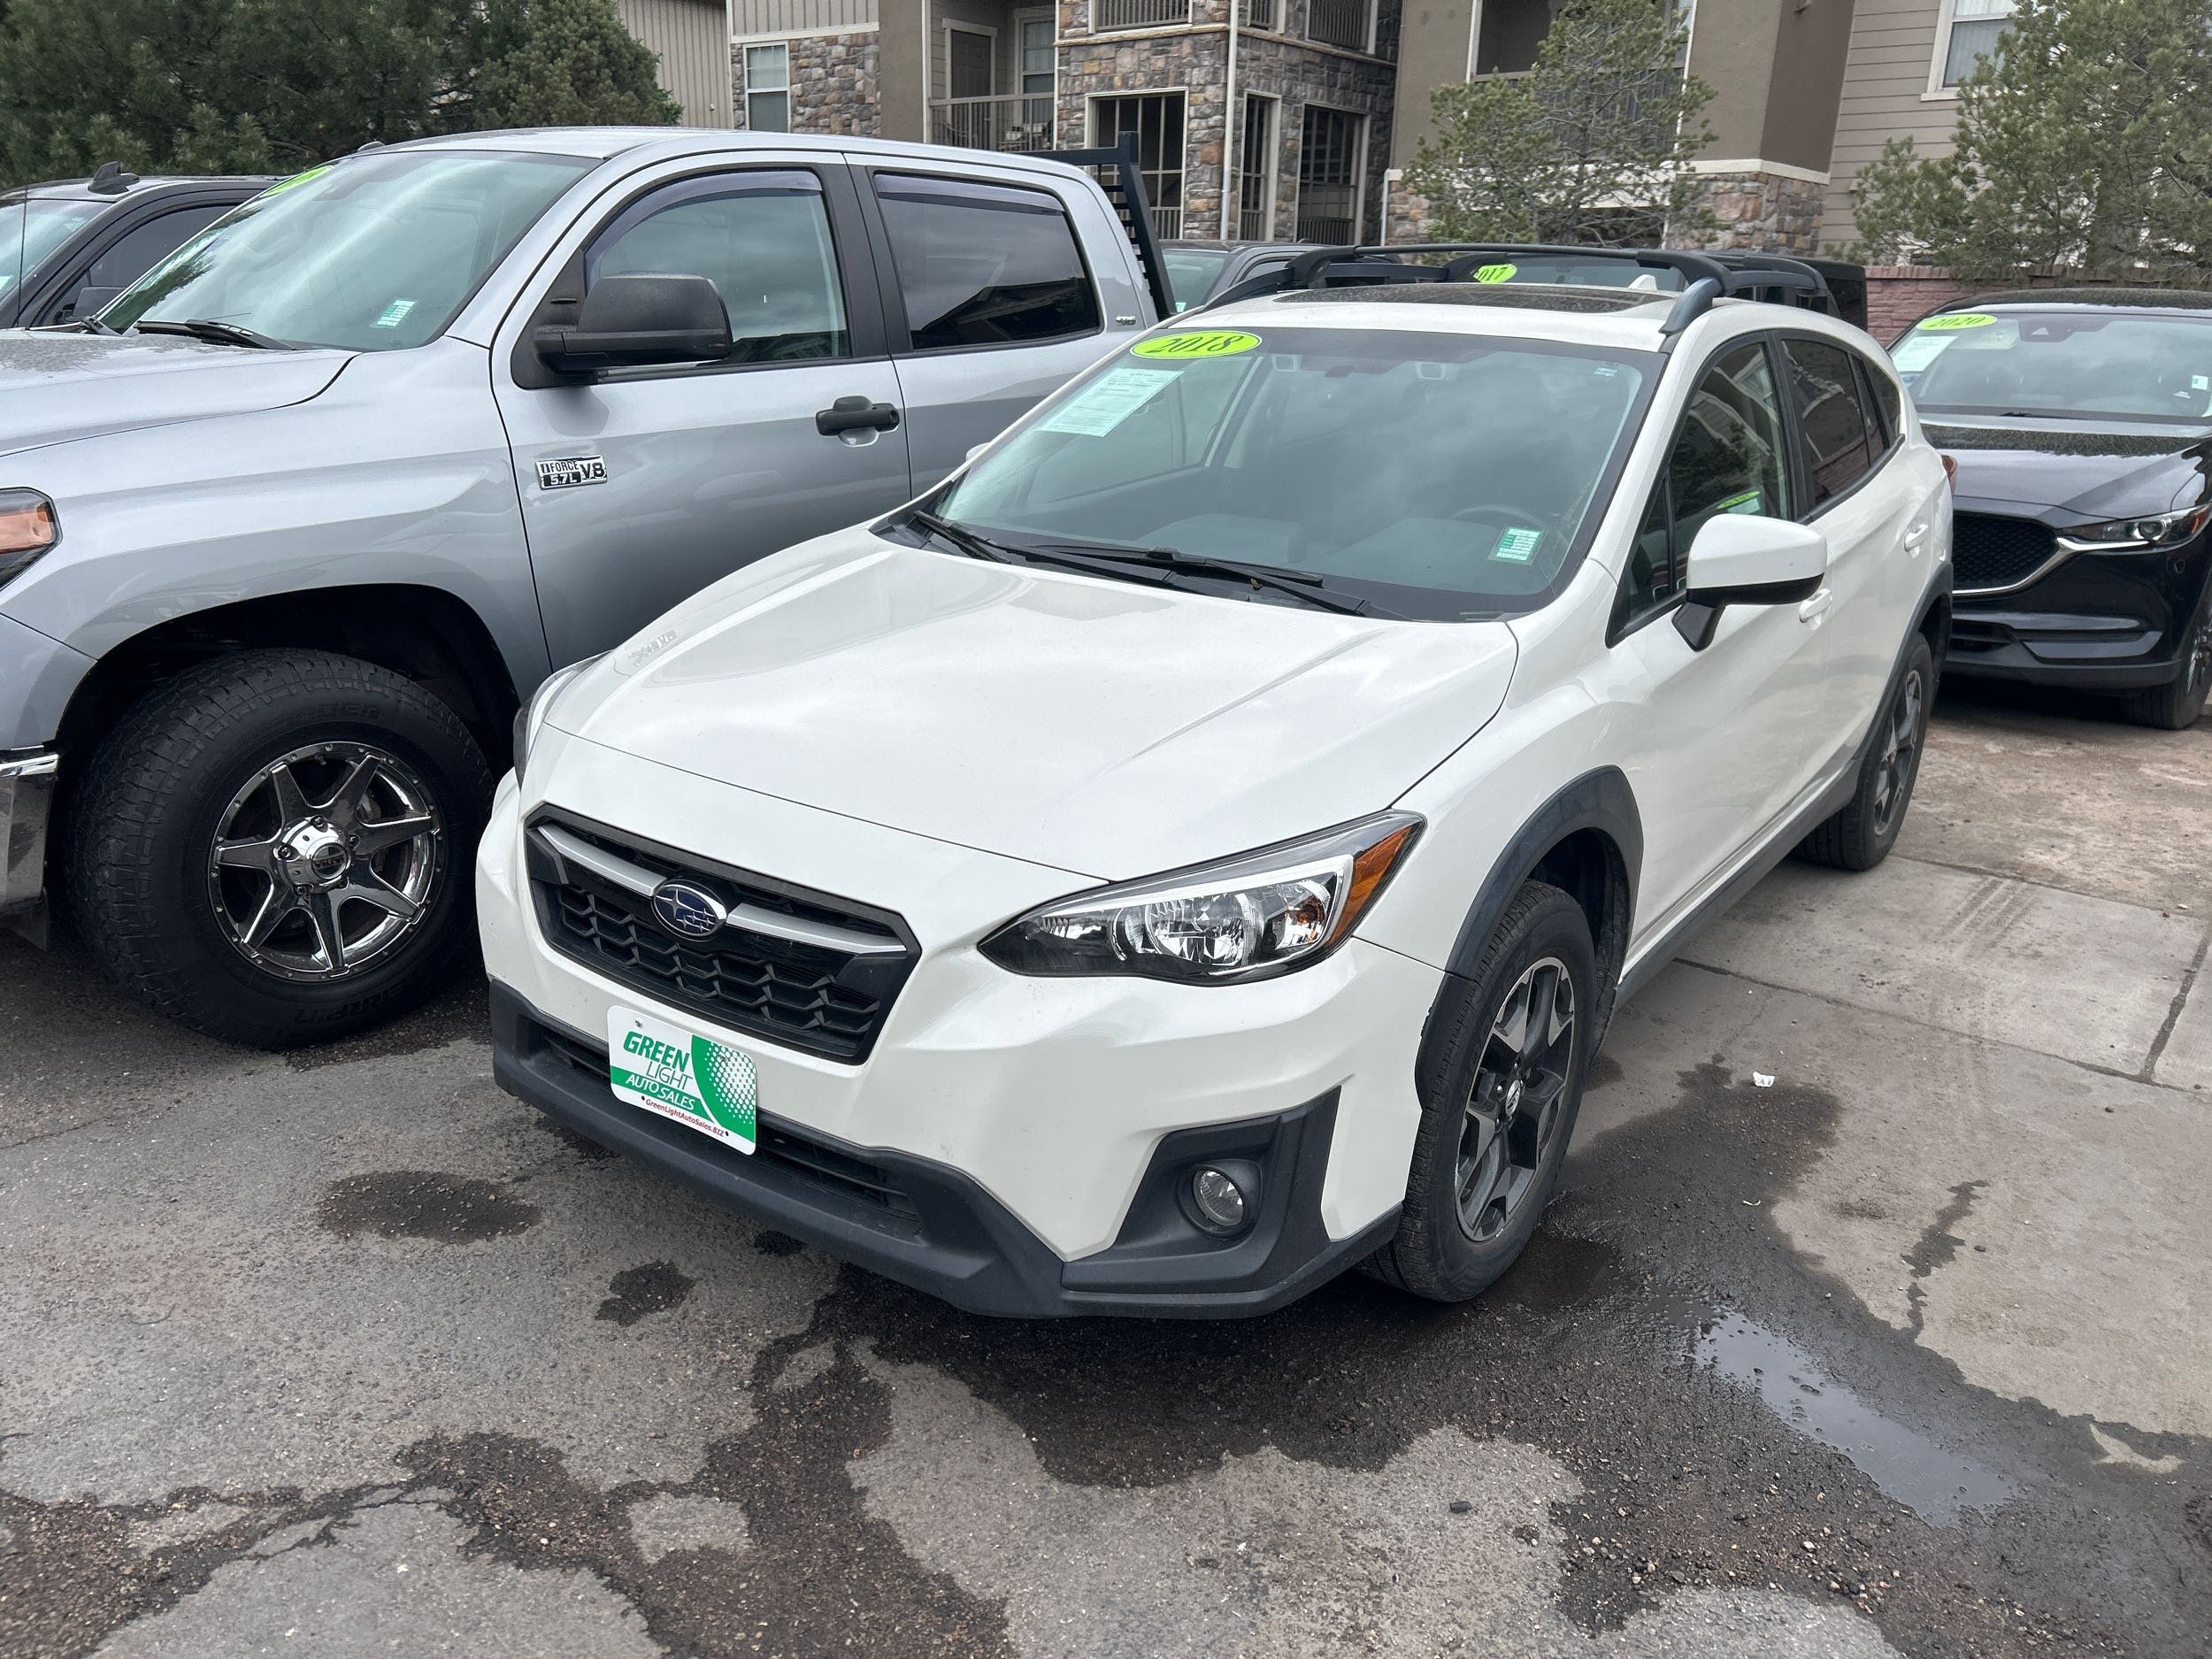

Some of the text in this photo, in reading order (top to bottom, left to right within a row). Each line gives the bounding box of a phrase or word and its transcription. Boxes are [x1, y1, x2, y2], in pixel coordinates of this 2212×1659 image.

[1925, 316, 1986, 328] 2020
[1145, 334, 1245, 355] 2018
[549, 462, 605, 485] 5.7L V8
[622, 1031, 690, 1072] GREEN
[646, 1061, 693, 1091] LIGHT
[626, 1074, 695, 1110] AUTO SALES
[645, 1098, 725, 1138] GreenLightAutoSales.BIZ
